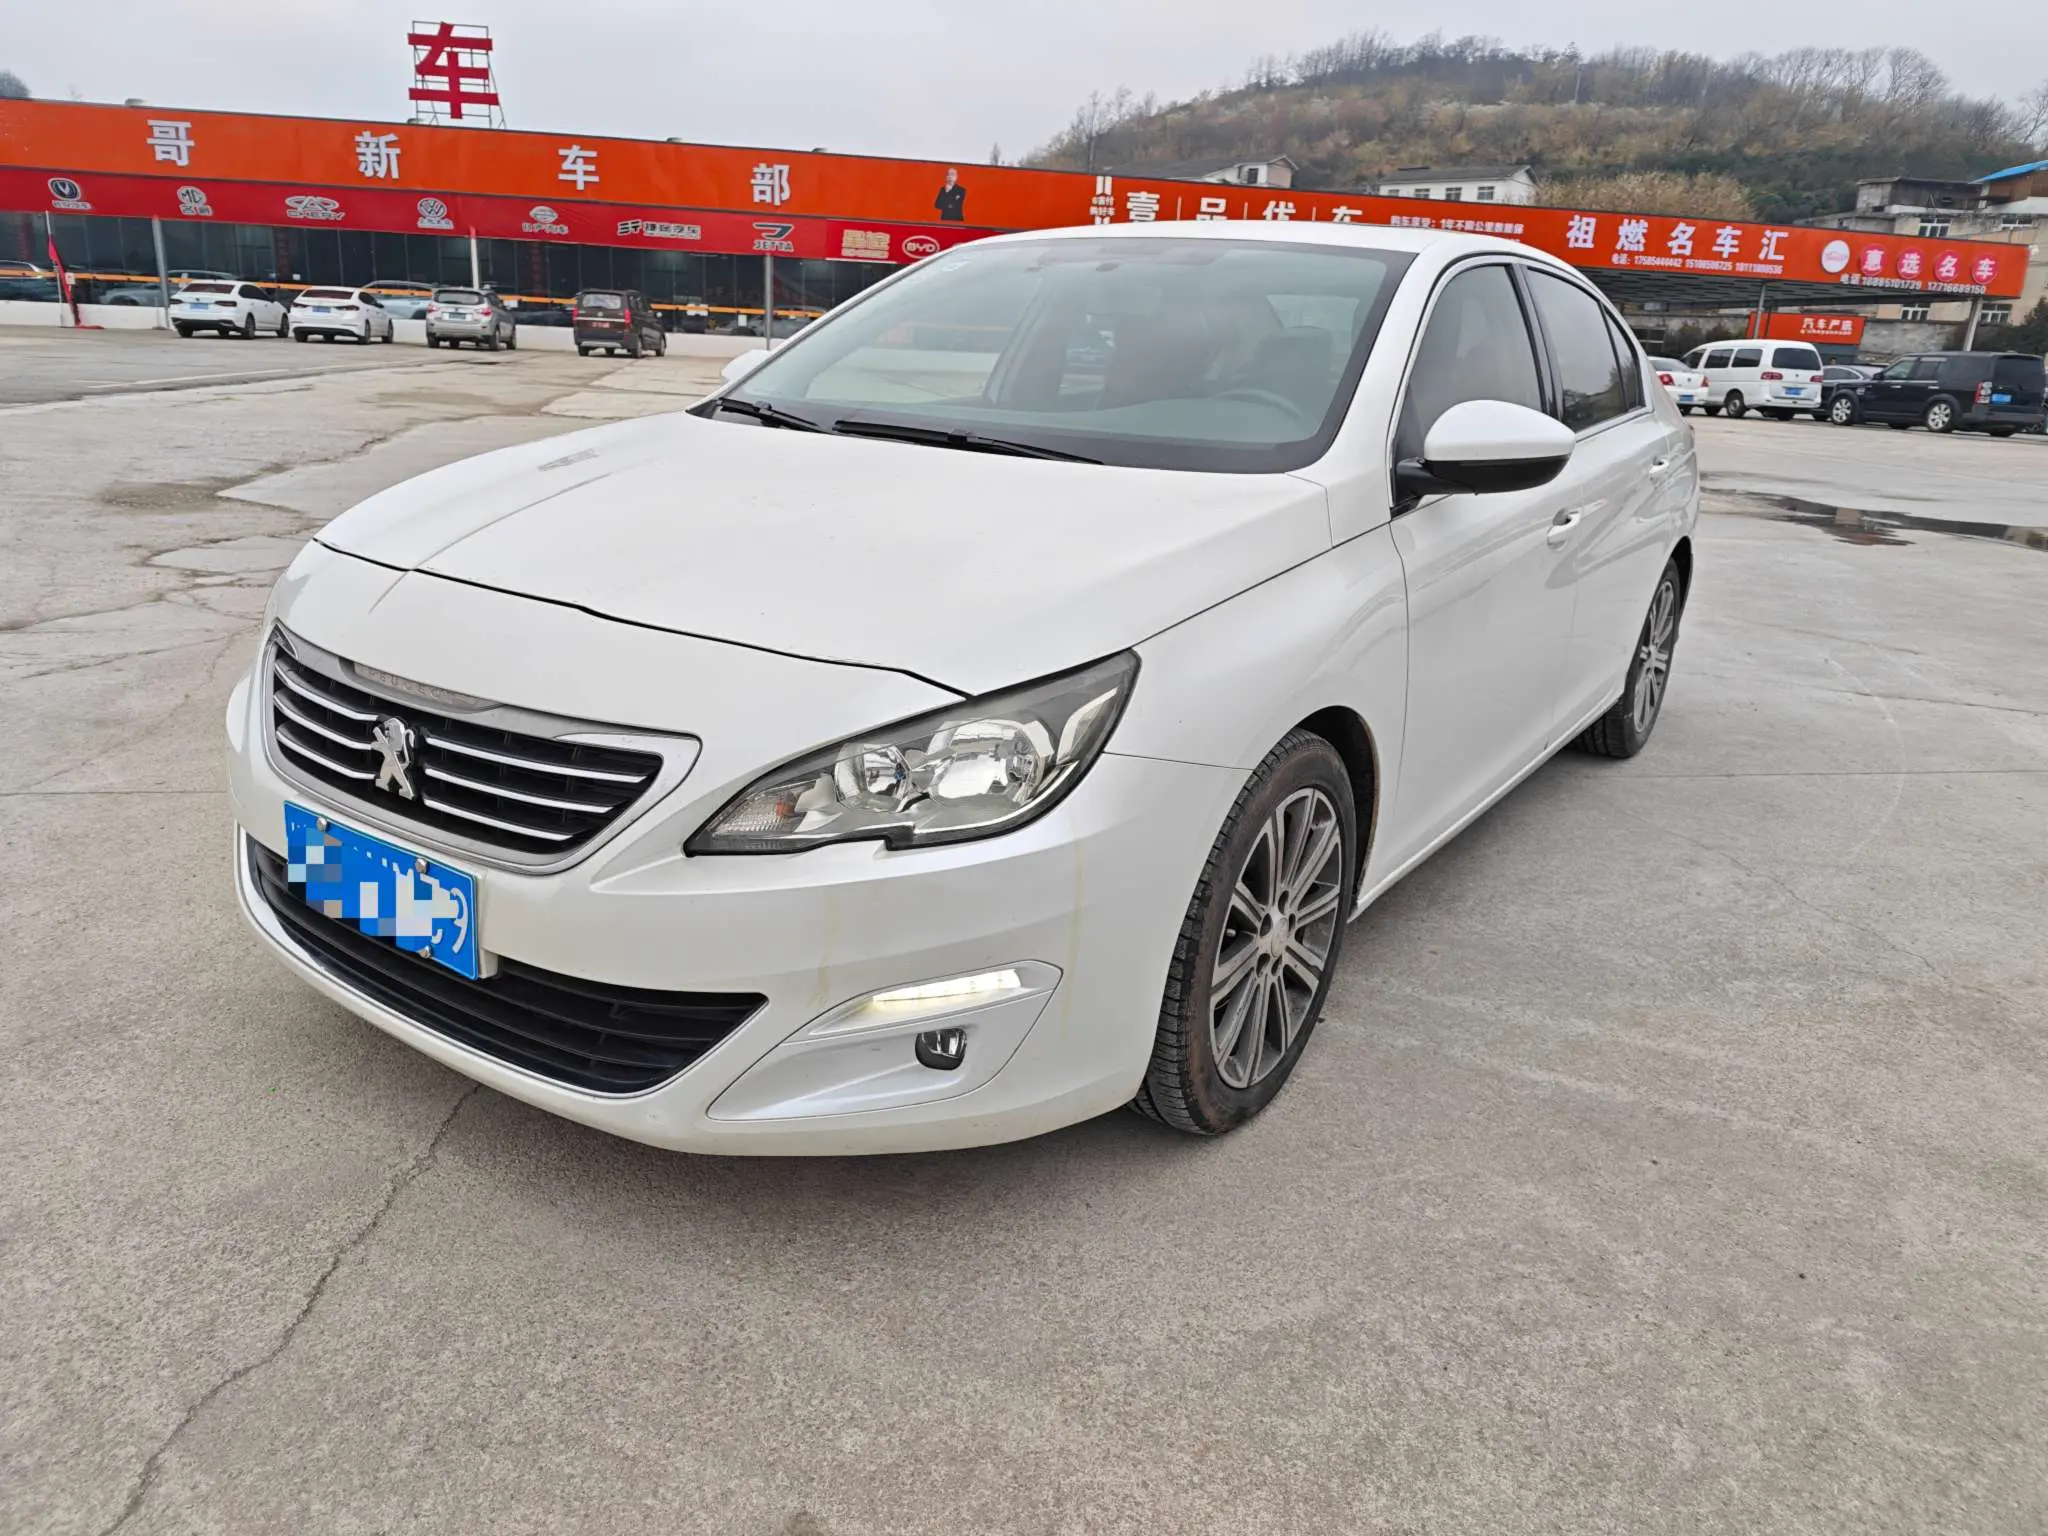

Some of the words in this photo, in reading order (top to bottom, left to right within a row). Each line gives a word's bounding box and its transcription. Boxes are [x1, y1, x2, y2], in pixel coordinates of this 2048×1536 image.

[407, 21, 500, 119] 车
[753, 240, 794, 253] JETTA
[906, 242, 938, 253] BYD
